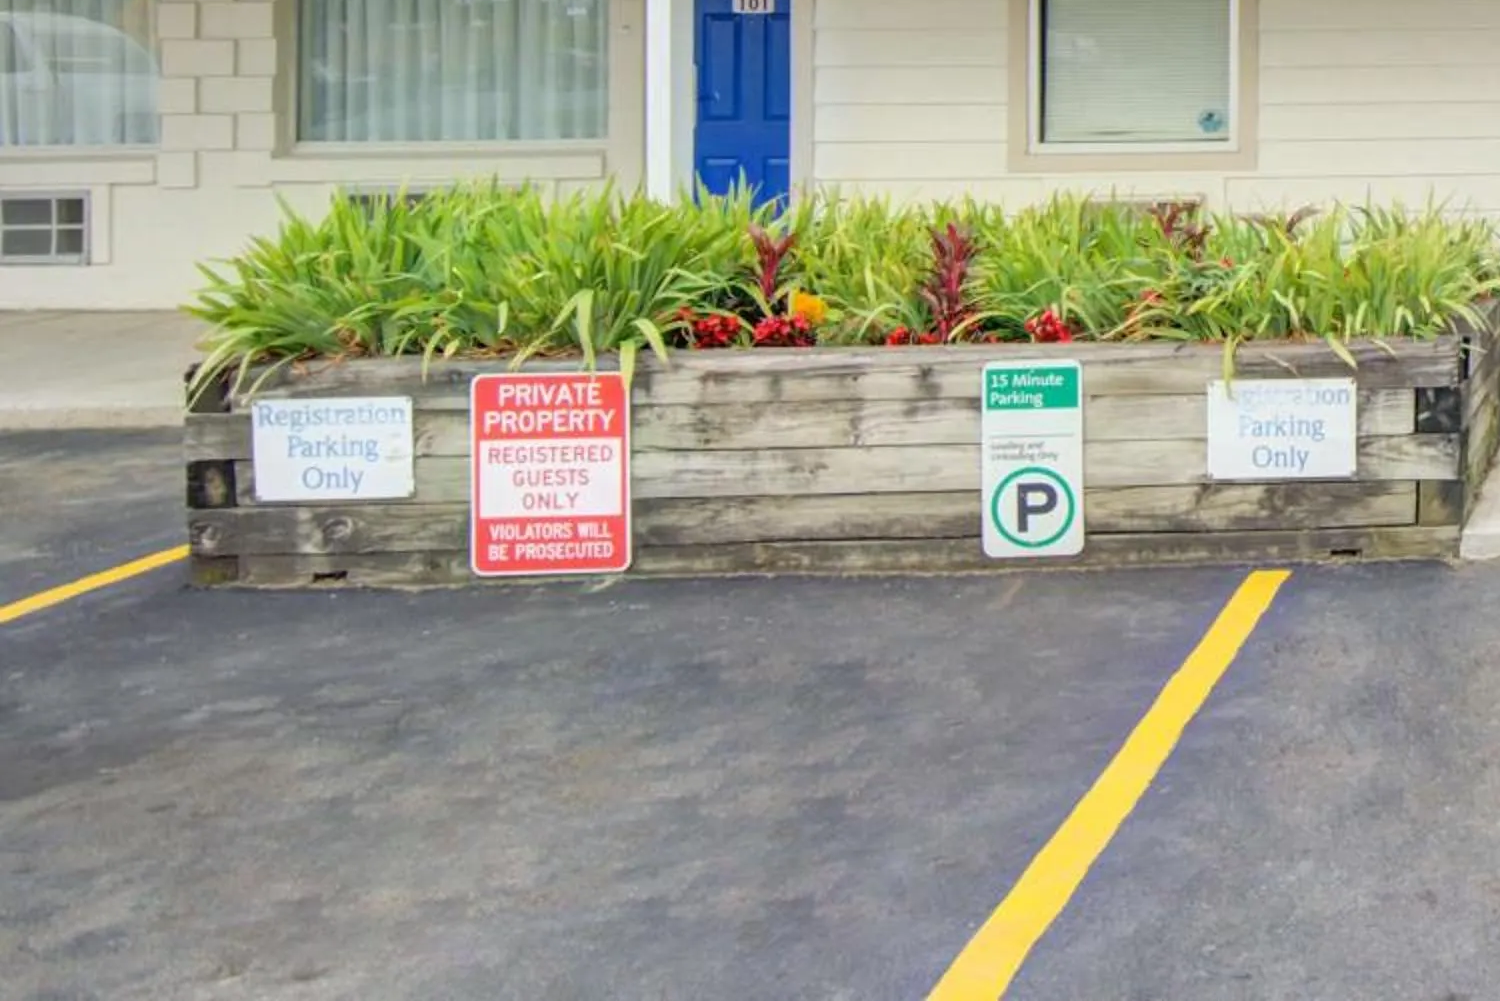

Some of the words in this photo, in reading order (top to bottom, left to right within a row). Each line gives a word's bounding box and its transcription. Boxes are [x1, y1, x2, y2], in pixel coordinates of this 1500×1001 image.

[990, 373, 1008, 388] 15
[1012, 372, 1065, 388] Minute
[498, 382, 603, 407] PRIVATE
[990, 390, 1044, 408] Parking
[258, 403, 406, 432] Registration
[483, 408, 616, 435] PROPERTY
[1239, 414, 1326, 442] Parking
[287, 434, 379, 462] Parking
[487, 445, 613, 464] REGISTERED
[1252, 445, 1310, 471] Only
[302, 464, 364, 494] Only
[512, 468, 590, 487] GUESTS
[521, 492, 579, 510] ONLY
[1017, 482, 1058, 533] P
[488, 521, 574, 541] VIOLATORS
[576, 520, 613, 539] WILL
[487, 543, 509, 561] BE
[514, 540, 613, 560] PROSECUTED
